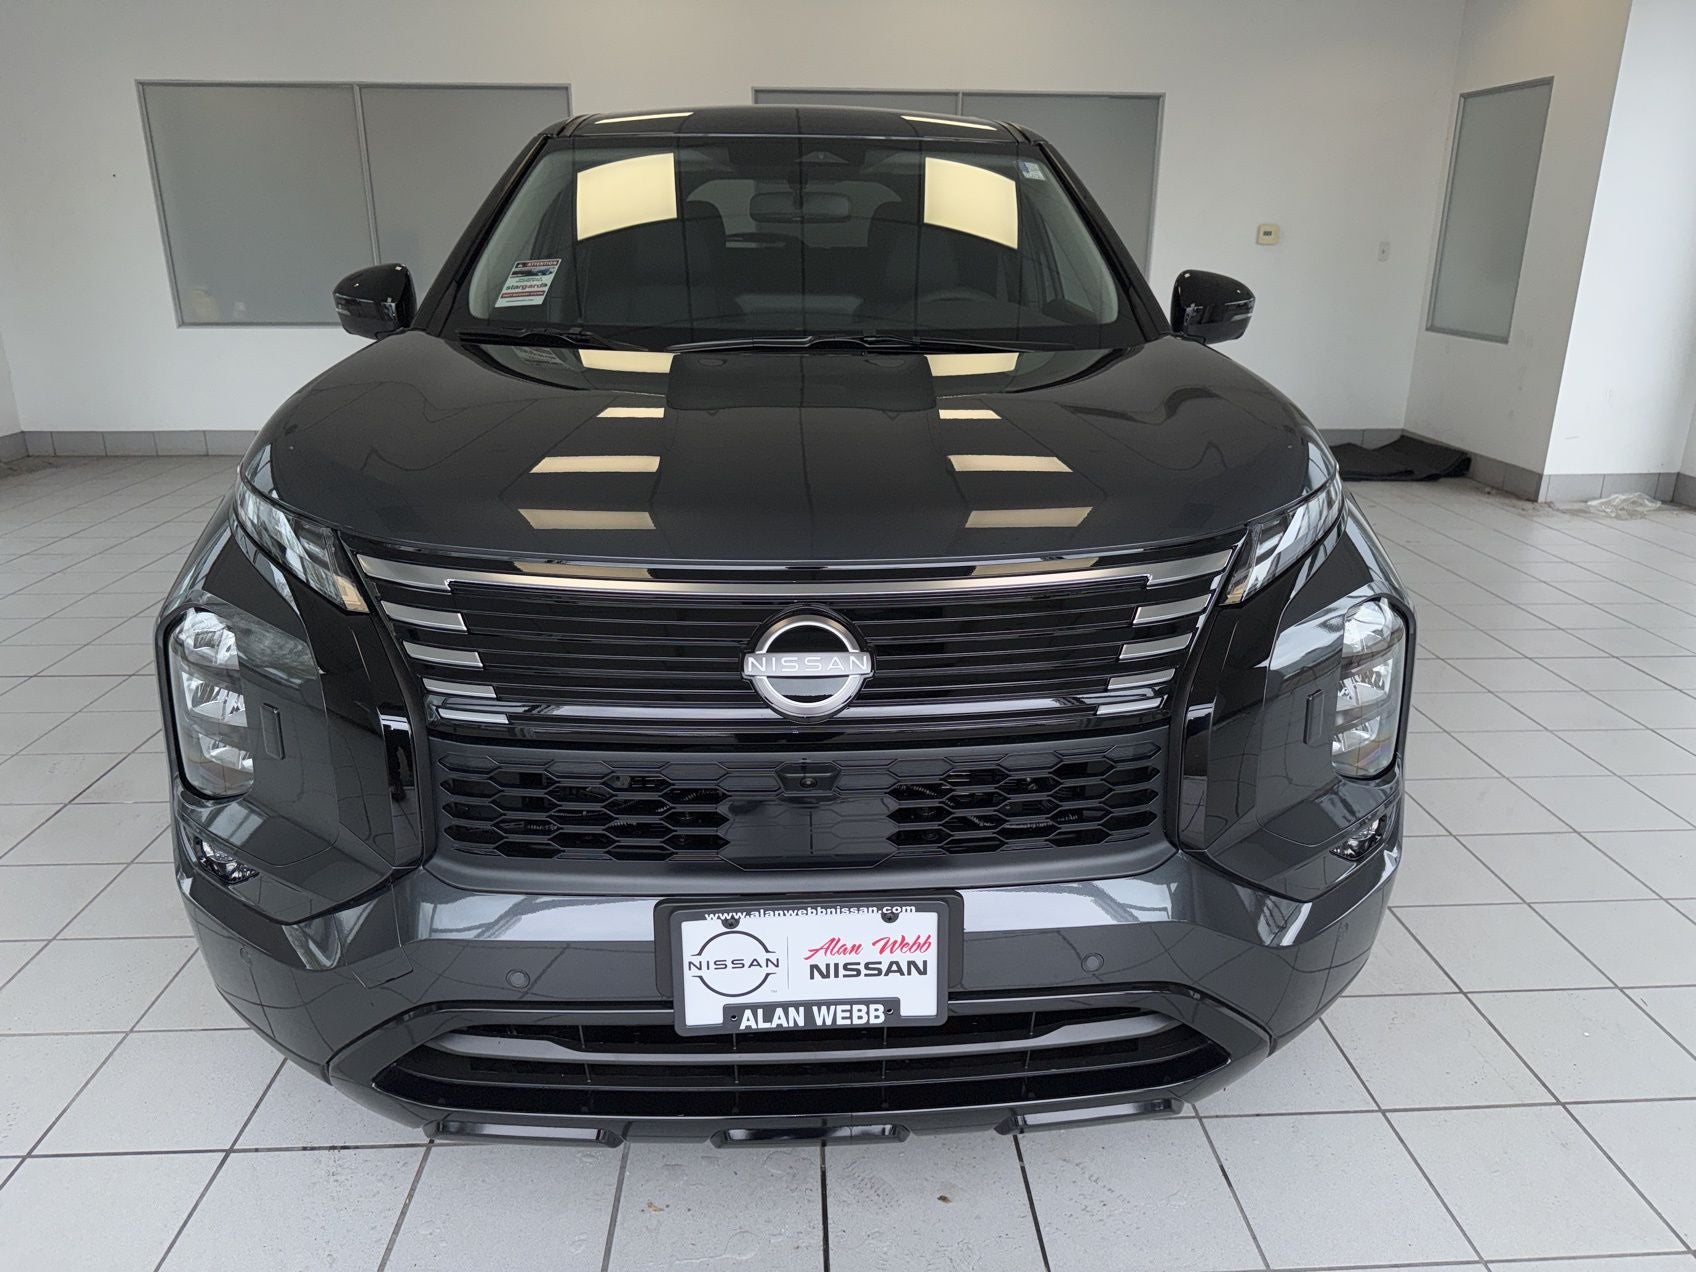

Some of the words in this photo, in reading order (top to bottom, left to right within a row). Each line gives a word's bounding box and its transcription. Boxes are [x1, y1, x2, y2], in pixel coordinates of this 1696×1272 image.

[747, 655, 867, 672] NISSAN
[704, 905, 916, 920] www.alanwebbnissan.com
[803, 936, 864, 961] Alan
[871, 934, 932, 955] Webb
[688, 957, 780, 972] NISSAN
[809, 959, 928, 980] NISSAN
[739, 1006, 805, 1030] ALAN
[812, 1004, 885, 1026] WEBB
